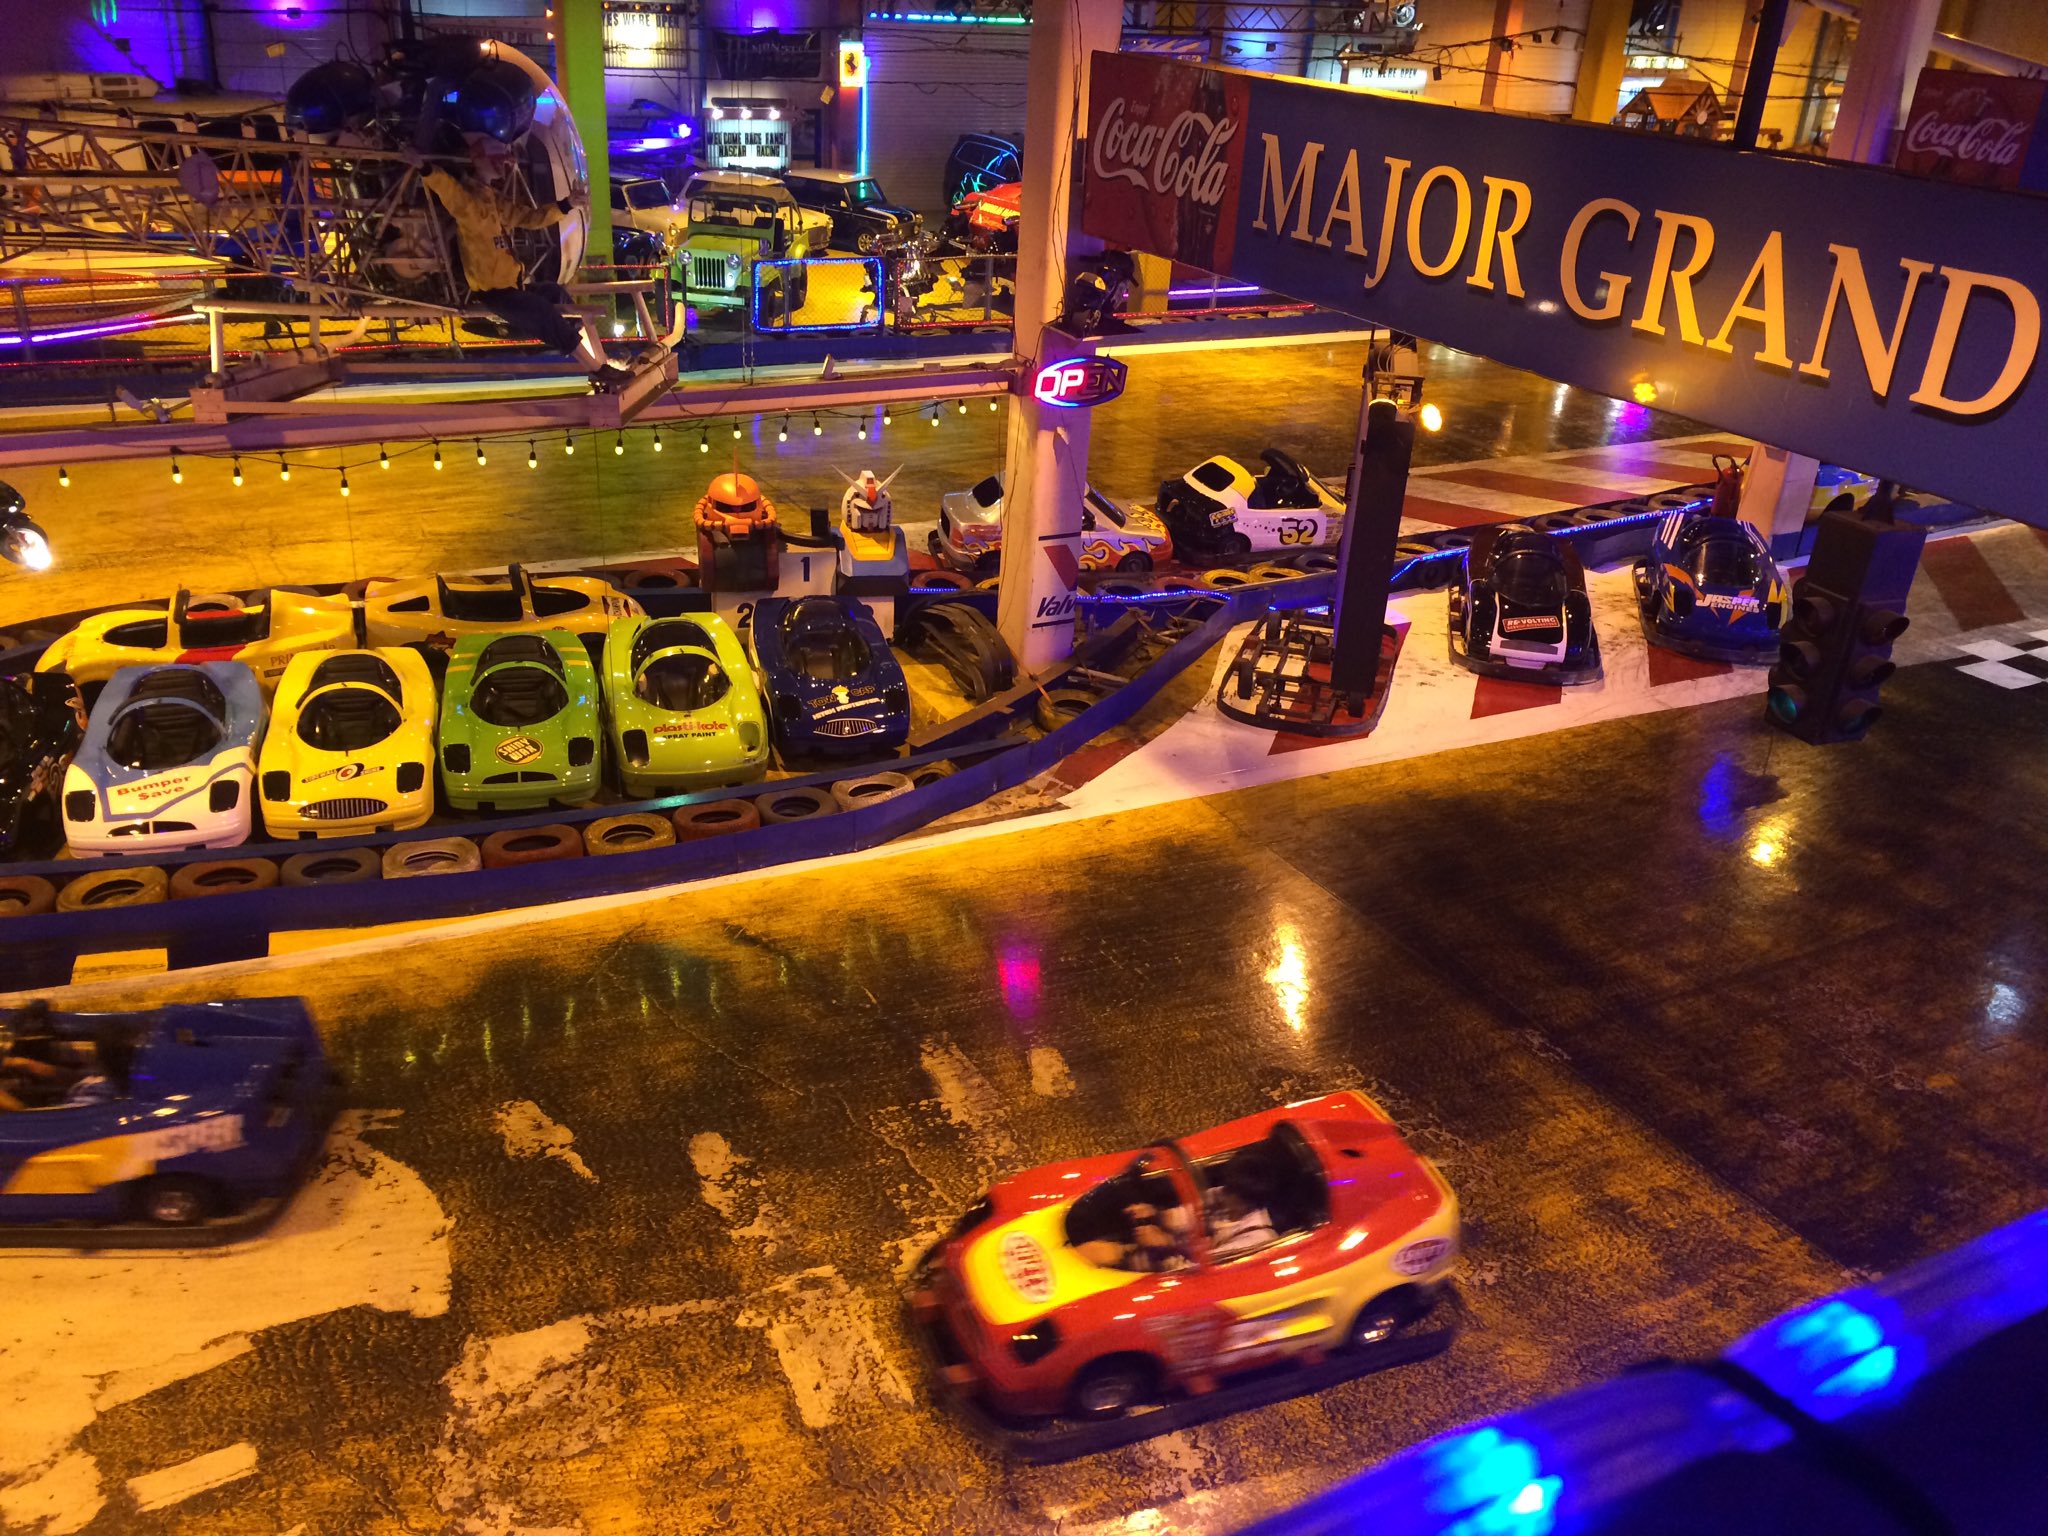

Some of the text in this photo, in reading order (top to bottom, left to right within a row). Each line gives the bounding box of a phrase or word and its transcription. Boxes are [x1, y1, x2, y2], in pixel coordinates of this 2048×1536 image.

[656, 13, 680, 27] OPEN
[1361, 67, 1374, 78] YES
[1400, 68, 1417, 79] OPEN
[1906, 111, 2030, 165] Coca-Cola
[719, 145, 780, 158] NASCAR RACING
[1093, 97, 1239, 206] Coca-Cola
[1252, 132, 2041, 416] MAJOR GRAND
[1034, 368, 1127, 399] OPEN
[1280, 518, 1318, 545] 52
[800, 556, 810, 582] 1
[1695, 594, 1760, 608] JASPER
[1711, 602, 1760, 614] ENGINES
[736, 602, 755, 629] 2
[498, 737, 530, 756] SHINY
[508, 744, 538, 761] WAX
[117, 776, 191, 796] Bumper
